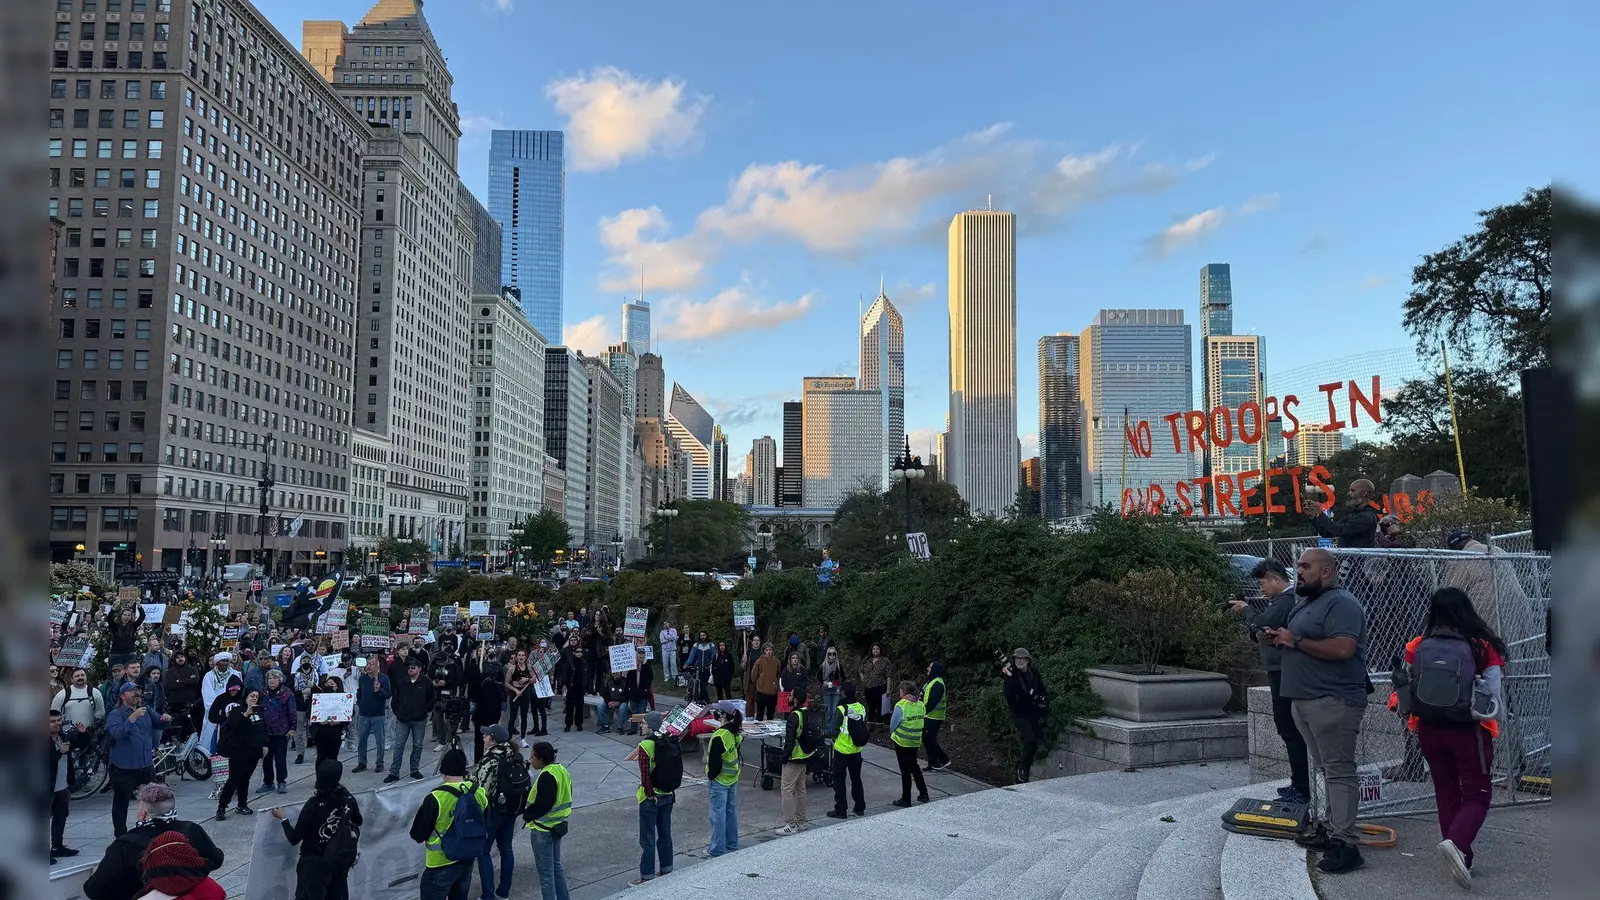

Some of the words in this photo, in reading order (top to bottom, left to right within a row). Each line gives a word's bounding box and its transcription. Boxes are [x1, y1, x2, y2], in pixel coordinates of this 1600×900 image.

[1126, 420, 1152, 458] NO
[1164, 394, 1300, 453] TROOPS
[1318, 375, 1383, 433] IN
[1176, 465, 1336, 518] STREETS
[1358, 787, 1380, 802] NATI
